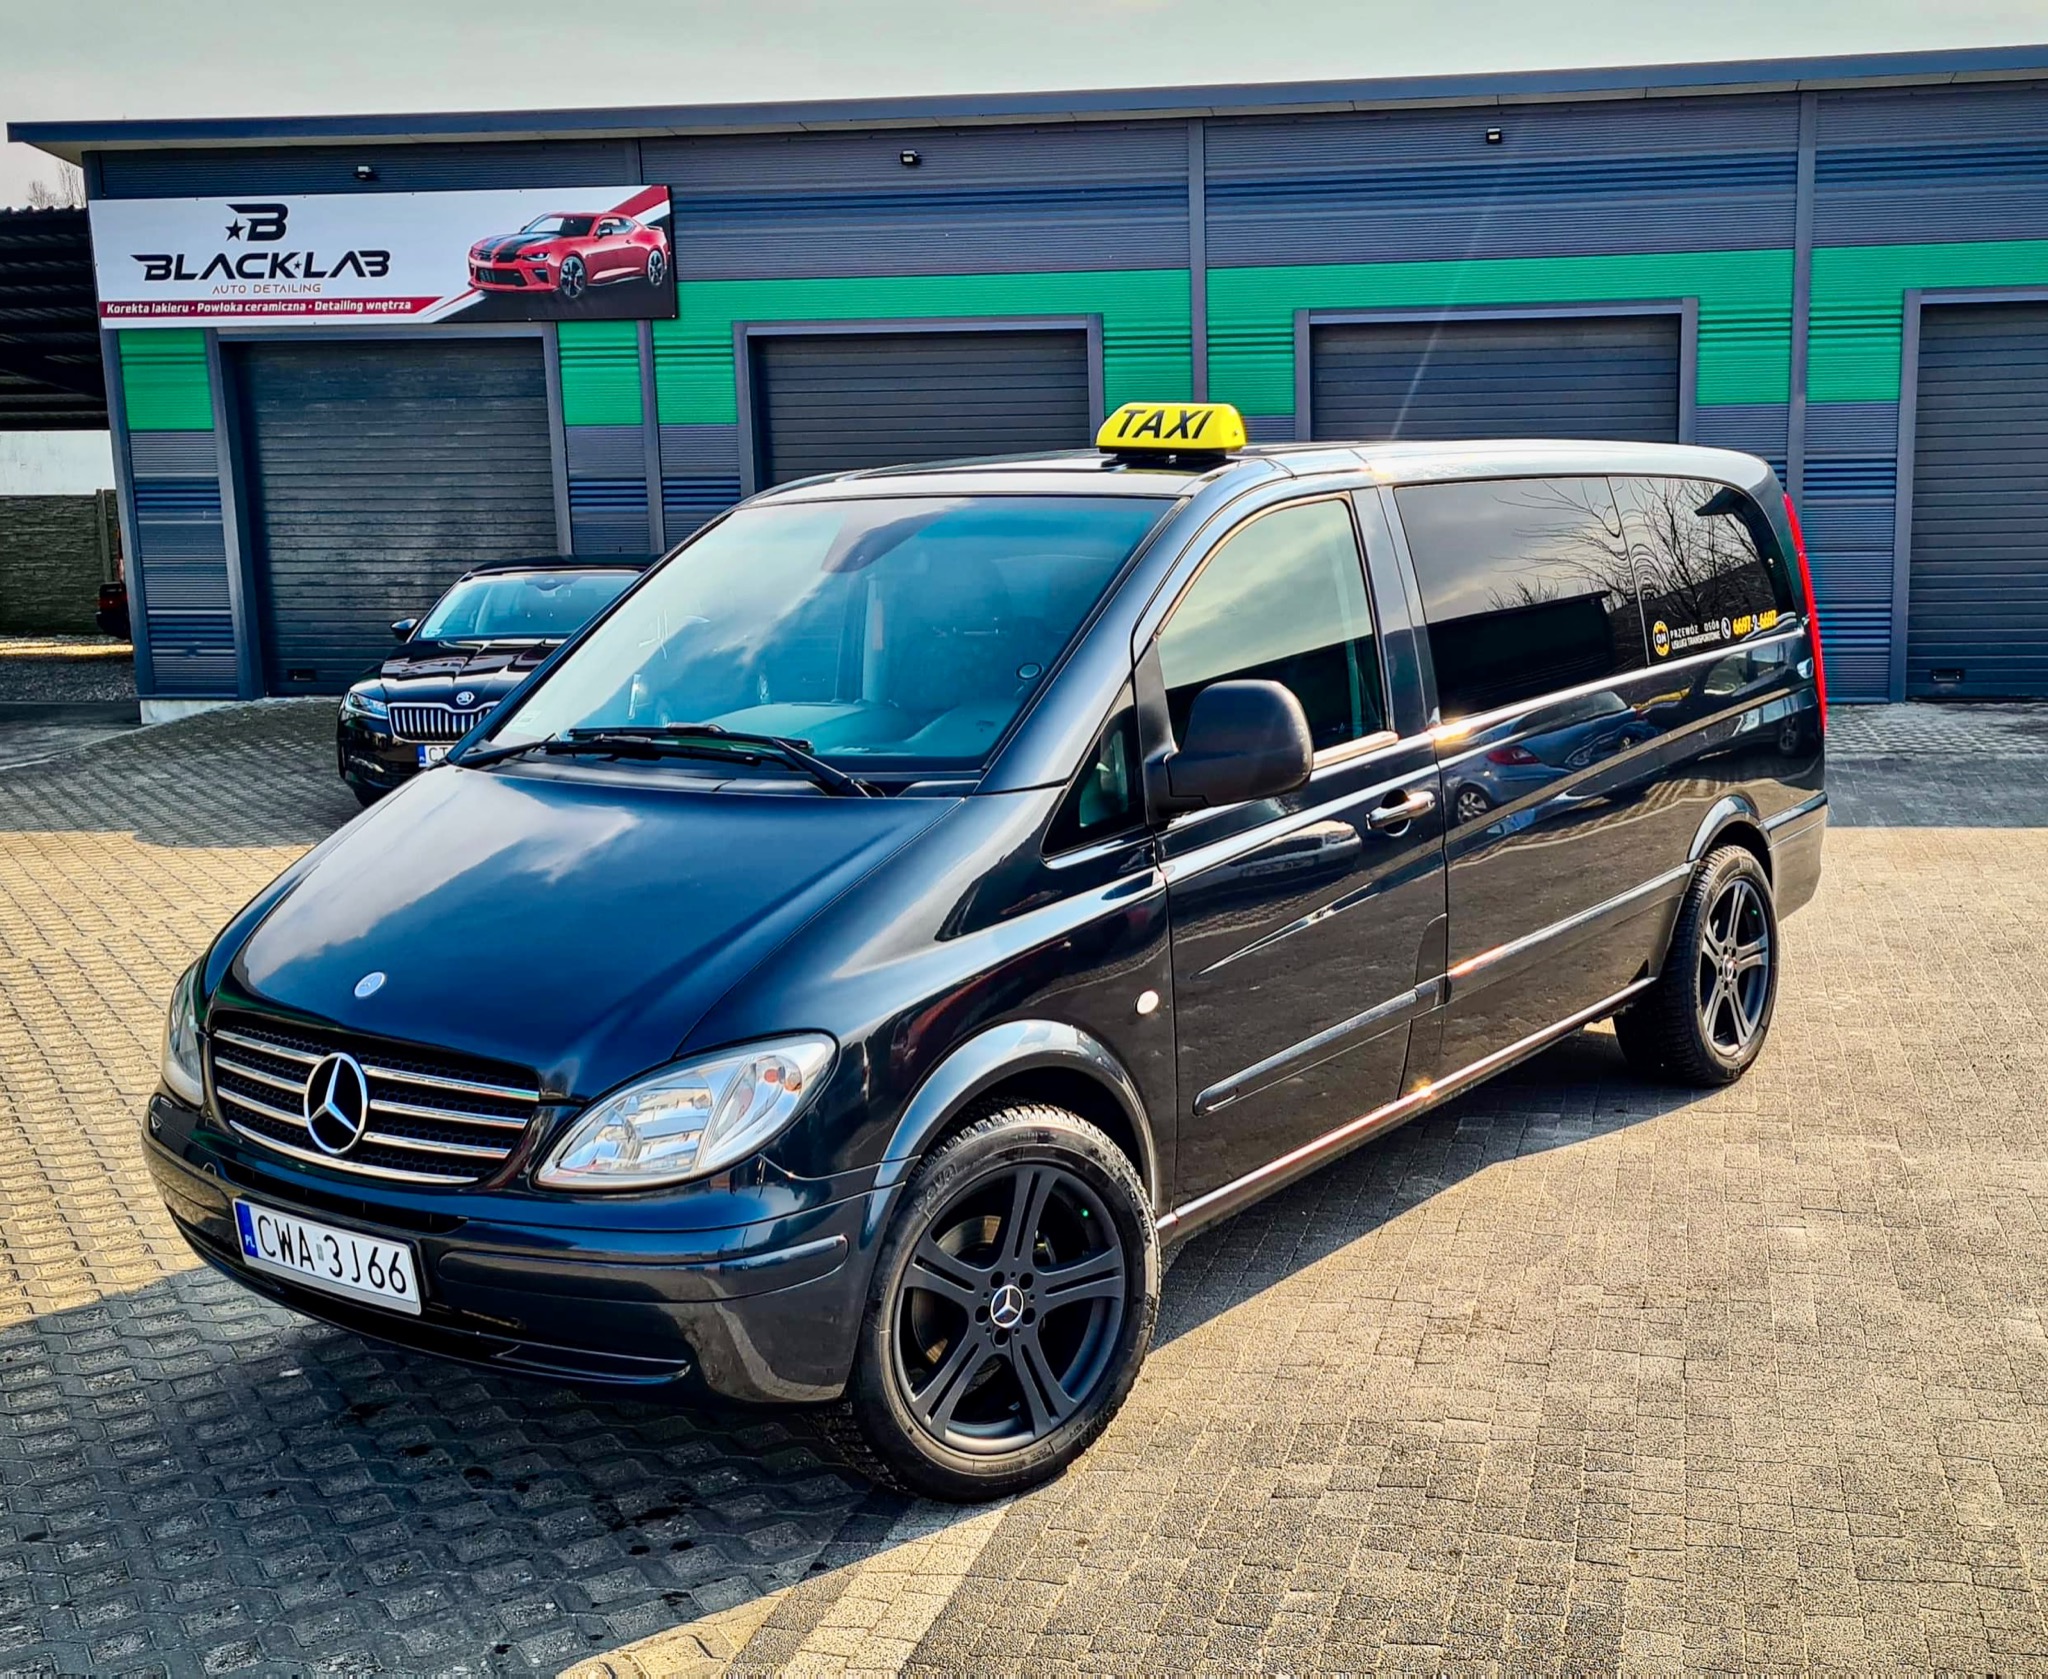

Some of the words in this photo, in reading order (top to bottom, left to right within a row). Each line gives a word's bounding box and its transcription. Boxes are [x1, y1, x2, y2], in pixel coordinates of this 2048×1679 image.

[212, 284, 247, 295] AUTO
[253, 283, 321, 294] DETAILING
[106, 303, 150, 314] Korekta
[152, 302, 189, 313] lakieru
[197, 302, 243, 313] Powłoka
[245, 301, 306, 312] ceramiczna
[314, 300, 364, 312] Detailing
[366, 300, 412, 313] wnętrza
[1116, 409, 1215, 440] TAXI
[244, 1234, 256, 1249] PL
[257, 1214, 316, 1272] CWA
[323, 1233, 407, 1295] 3J66
